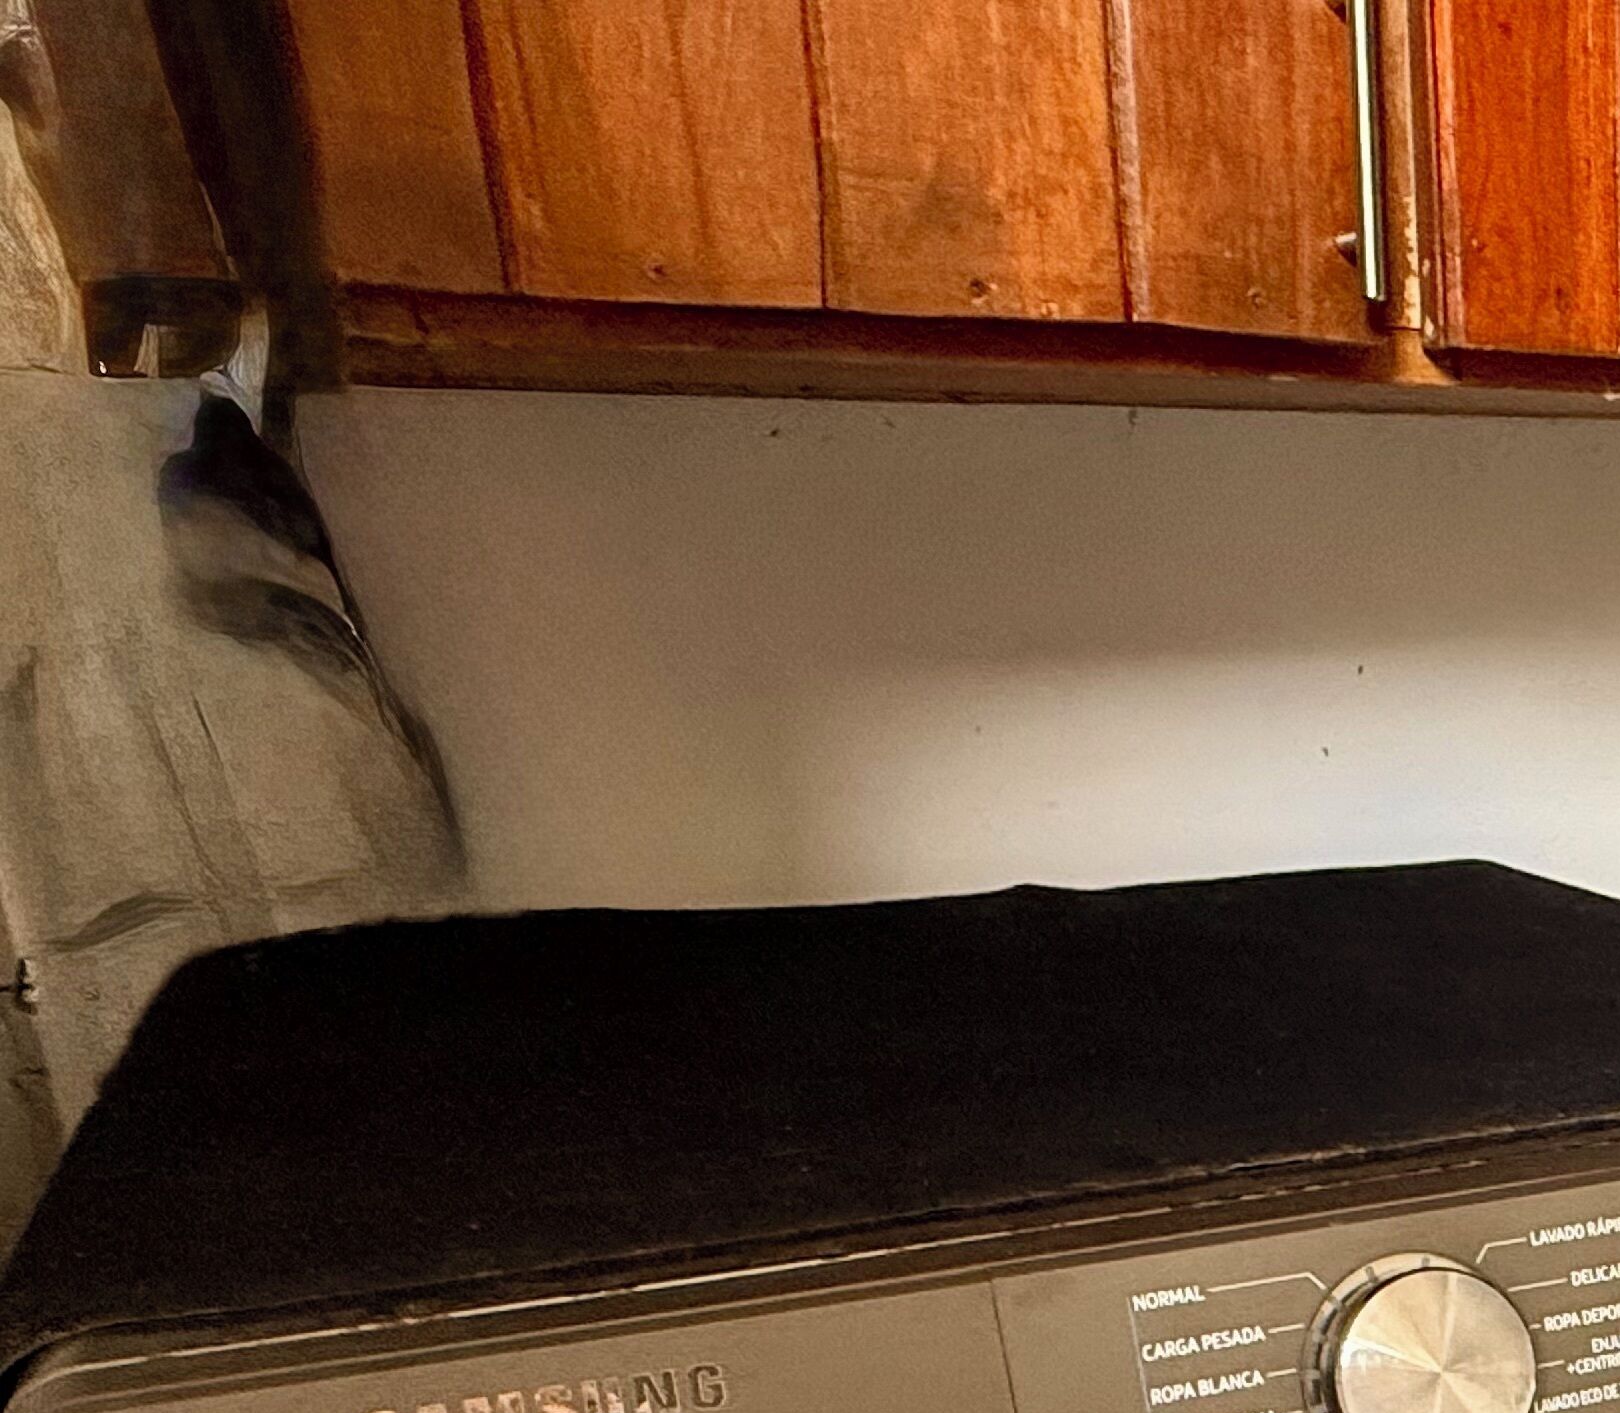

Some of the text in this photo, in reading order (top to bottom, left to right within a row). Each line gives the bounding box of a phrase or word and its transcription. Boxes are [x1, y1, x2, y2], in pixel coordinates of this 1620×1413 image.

[1529, 1222, 1585, 1246] LAVADO
[1132, 1285, 1206, 1312] NORMAL
[1543, 1311, 1581, 1331] ROPA
[1142, 1325, 1266, 1362] CARGA PESADA
[1150, 1369, 1265, 1406] ROPA BLANCA
[1580, 1386, 1603, 1406] ECO
[1603, 1382, 1620, 1401] DE
